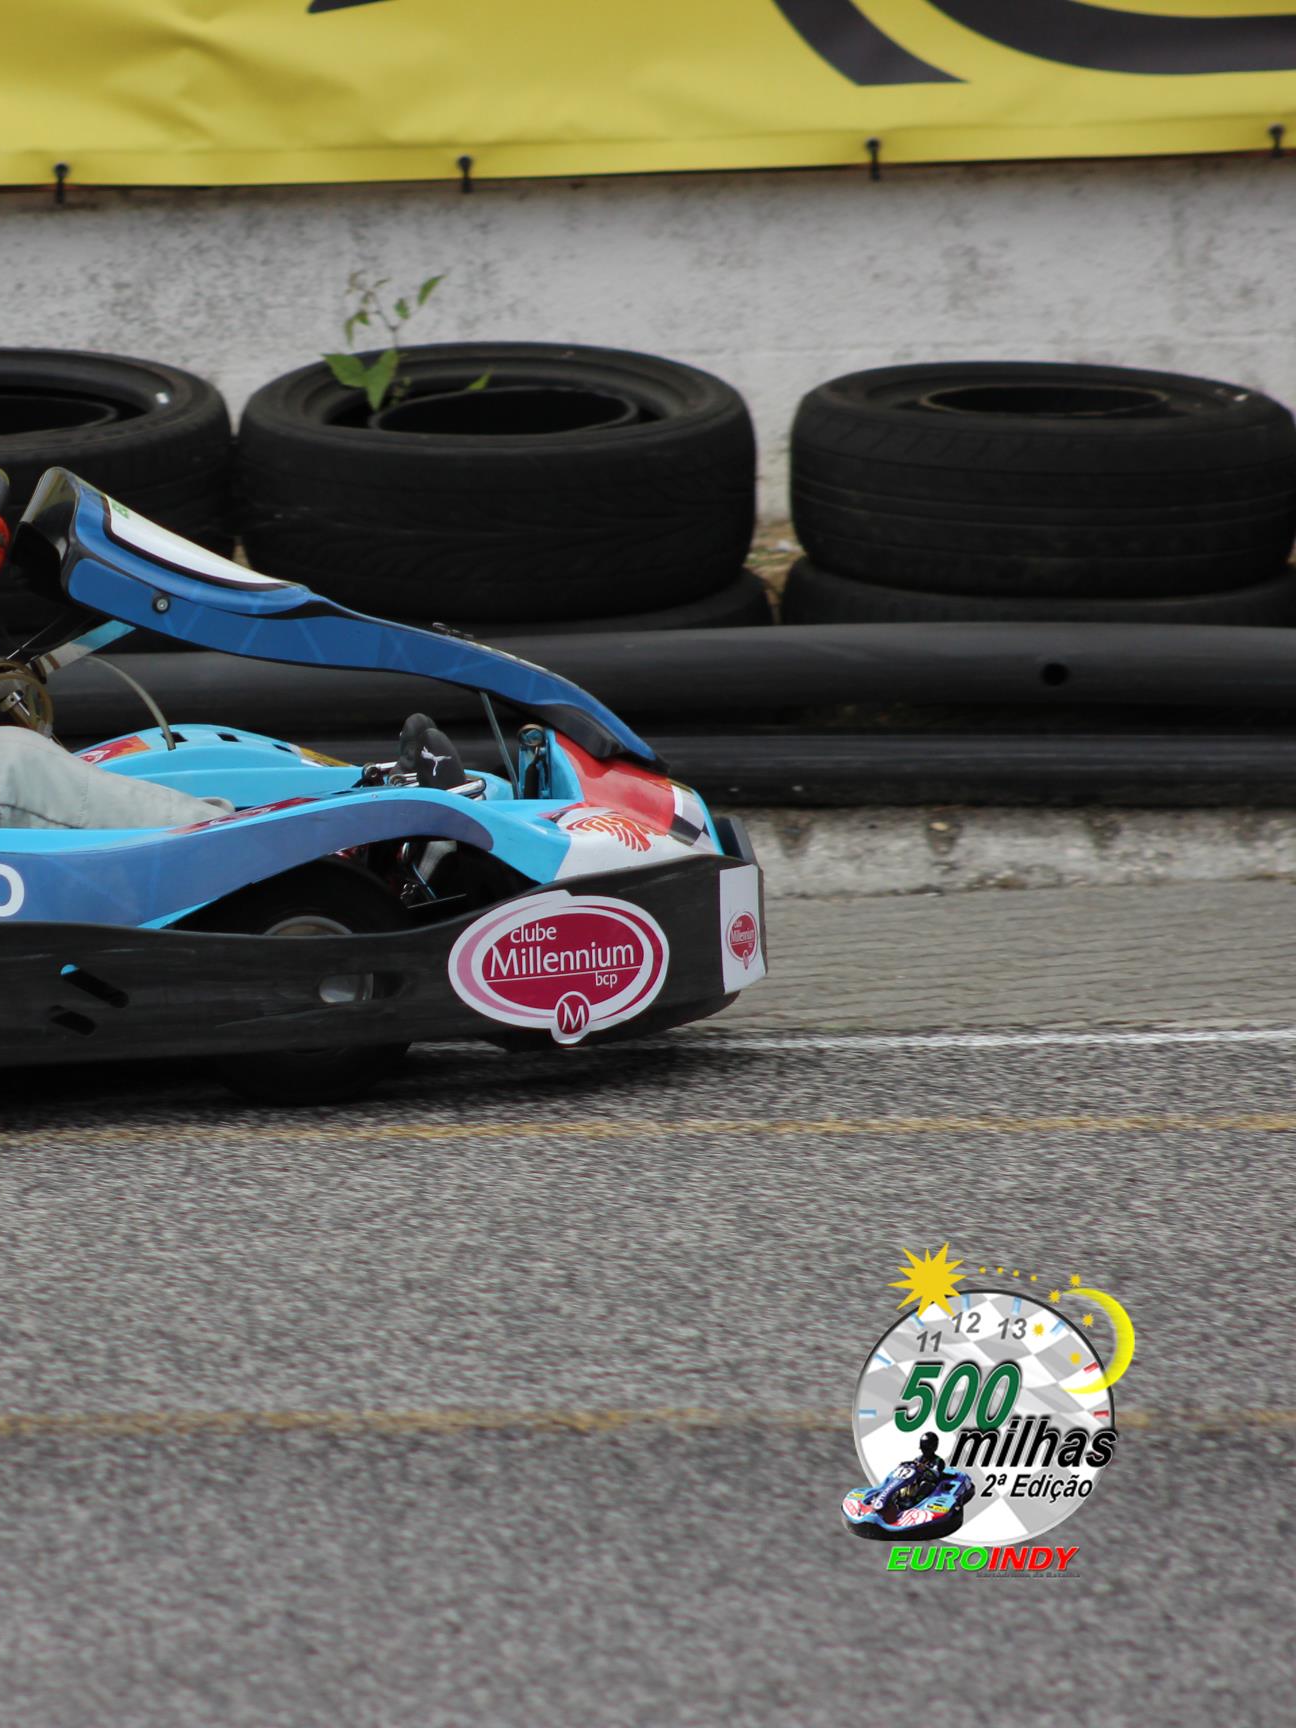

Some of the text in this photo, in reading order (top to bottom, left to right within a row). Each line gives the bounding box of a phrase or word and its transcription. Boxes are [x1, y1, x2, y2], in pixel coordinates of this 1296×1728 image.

[510, 923, 557, 944] clube
[490, 941, 635, 978] Millennium
[595, 971, 618, 988] bcp
